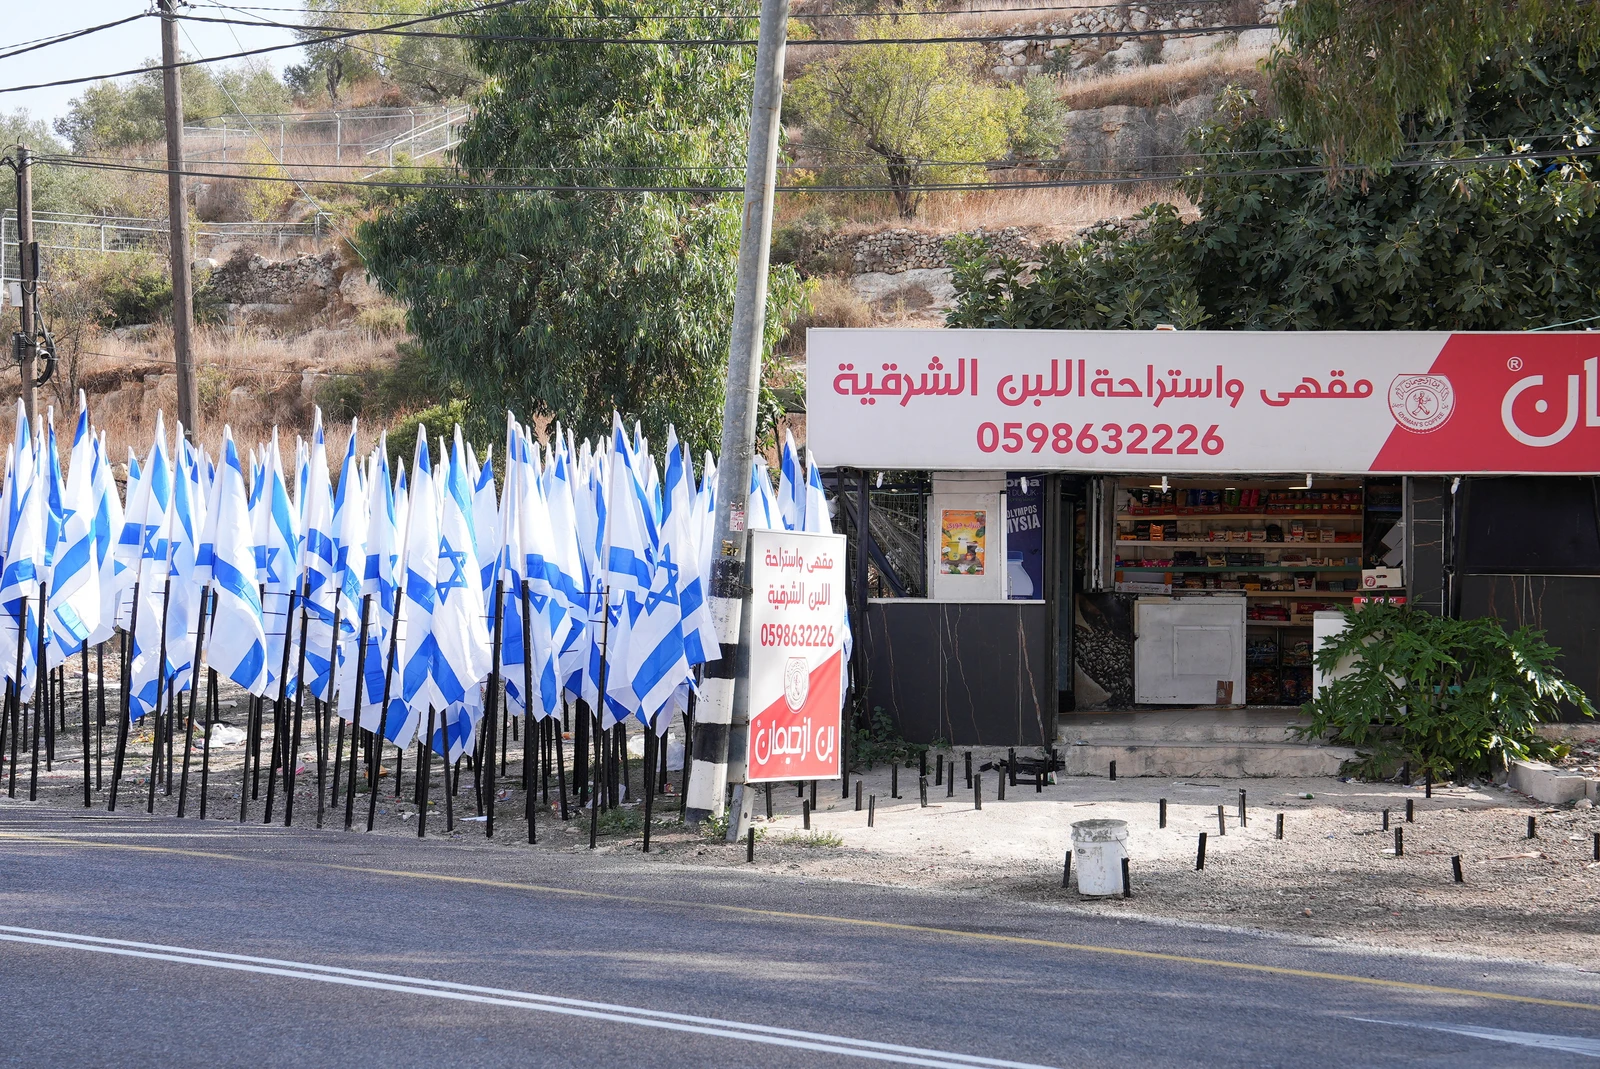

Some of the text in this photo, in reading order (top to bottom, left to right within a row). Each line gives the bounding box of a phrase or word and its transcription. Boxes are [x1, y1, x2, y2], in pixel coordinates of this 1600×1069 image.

[833, 356, 1374, 409] مقهى واستراحة اللبن الشرقية
[1424, 411, 1445, 427] COFFEE
[976, 421, 1224, 456] 0598632226
[765, 547, 833, 573] مقهى واستراحة
[767, 580, 831, 611] اللبن الشرقية
[760, 623, 835, 647] 0598632226
[815, 725, 835, 764] بن
